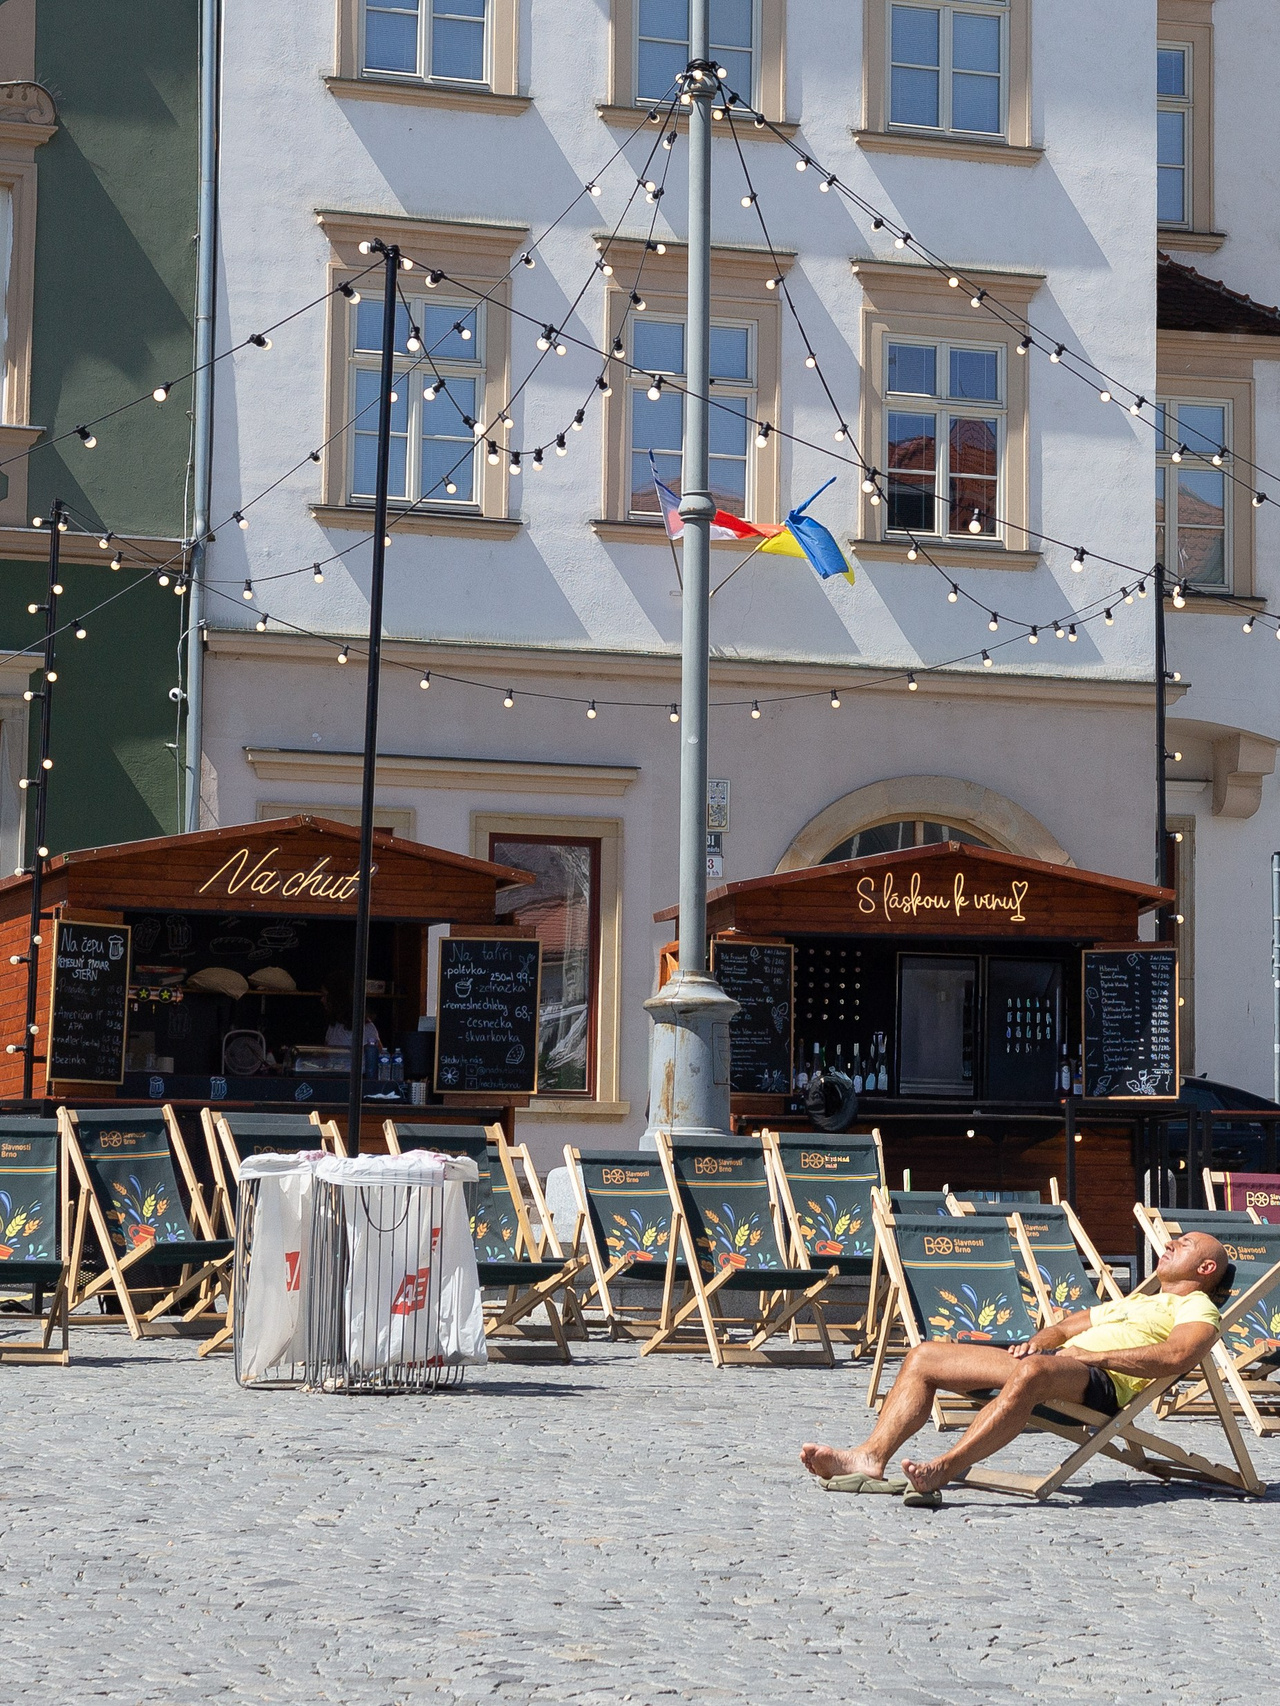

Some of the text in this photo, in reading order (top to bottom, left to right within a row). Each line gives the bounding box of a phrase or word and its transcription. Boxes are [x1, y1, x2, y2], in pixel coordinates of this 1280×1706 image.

[199, 848, 280, 894] Na
[856, 877, 876, 914] S
[884, 872, 950, 922] láskou
[954, 872, 969, 916] k
[60, 928, 104, 956] Na čepu
[450, 942, 472, 962] Na
[72, 968, 98, 981] STERN
[1024, 1224, 1049, 1232] Slavnosti
[954, 1239, 984, 1247] Slavnosti
